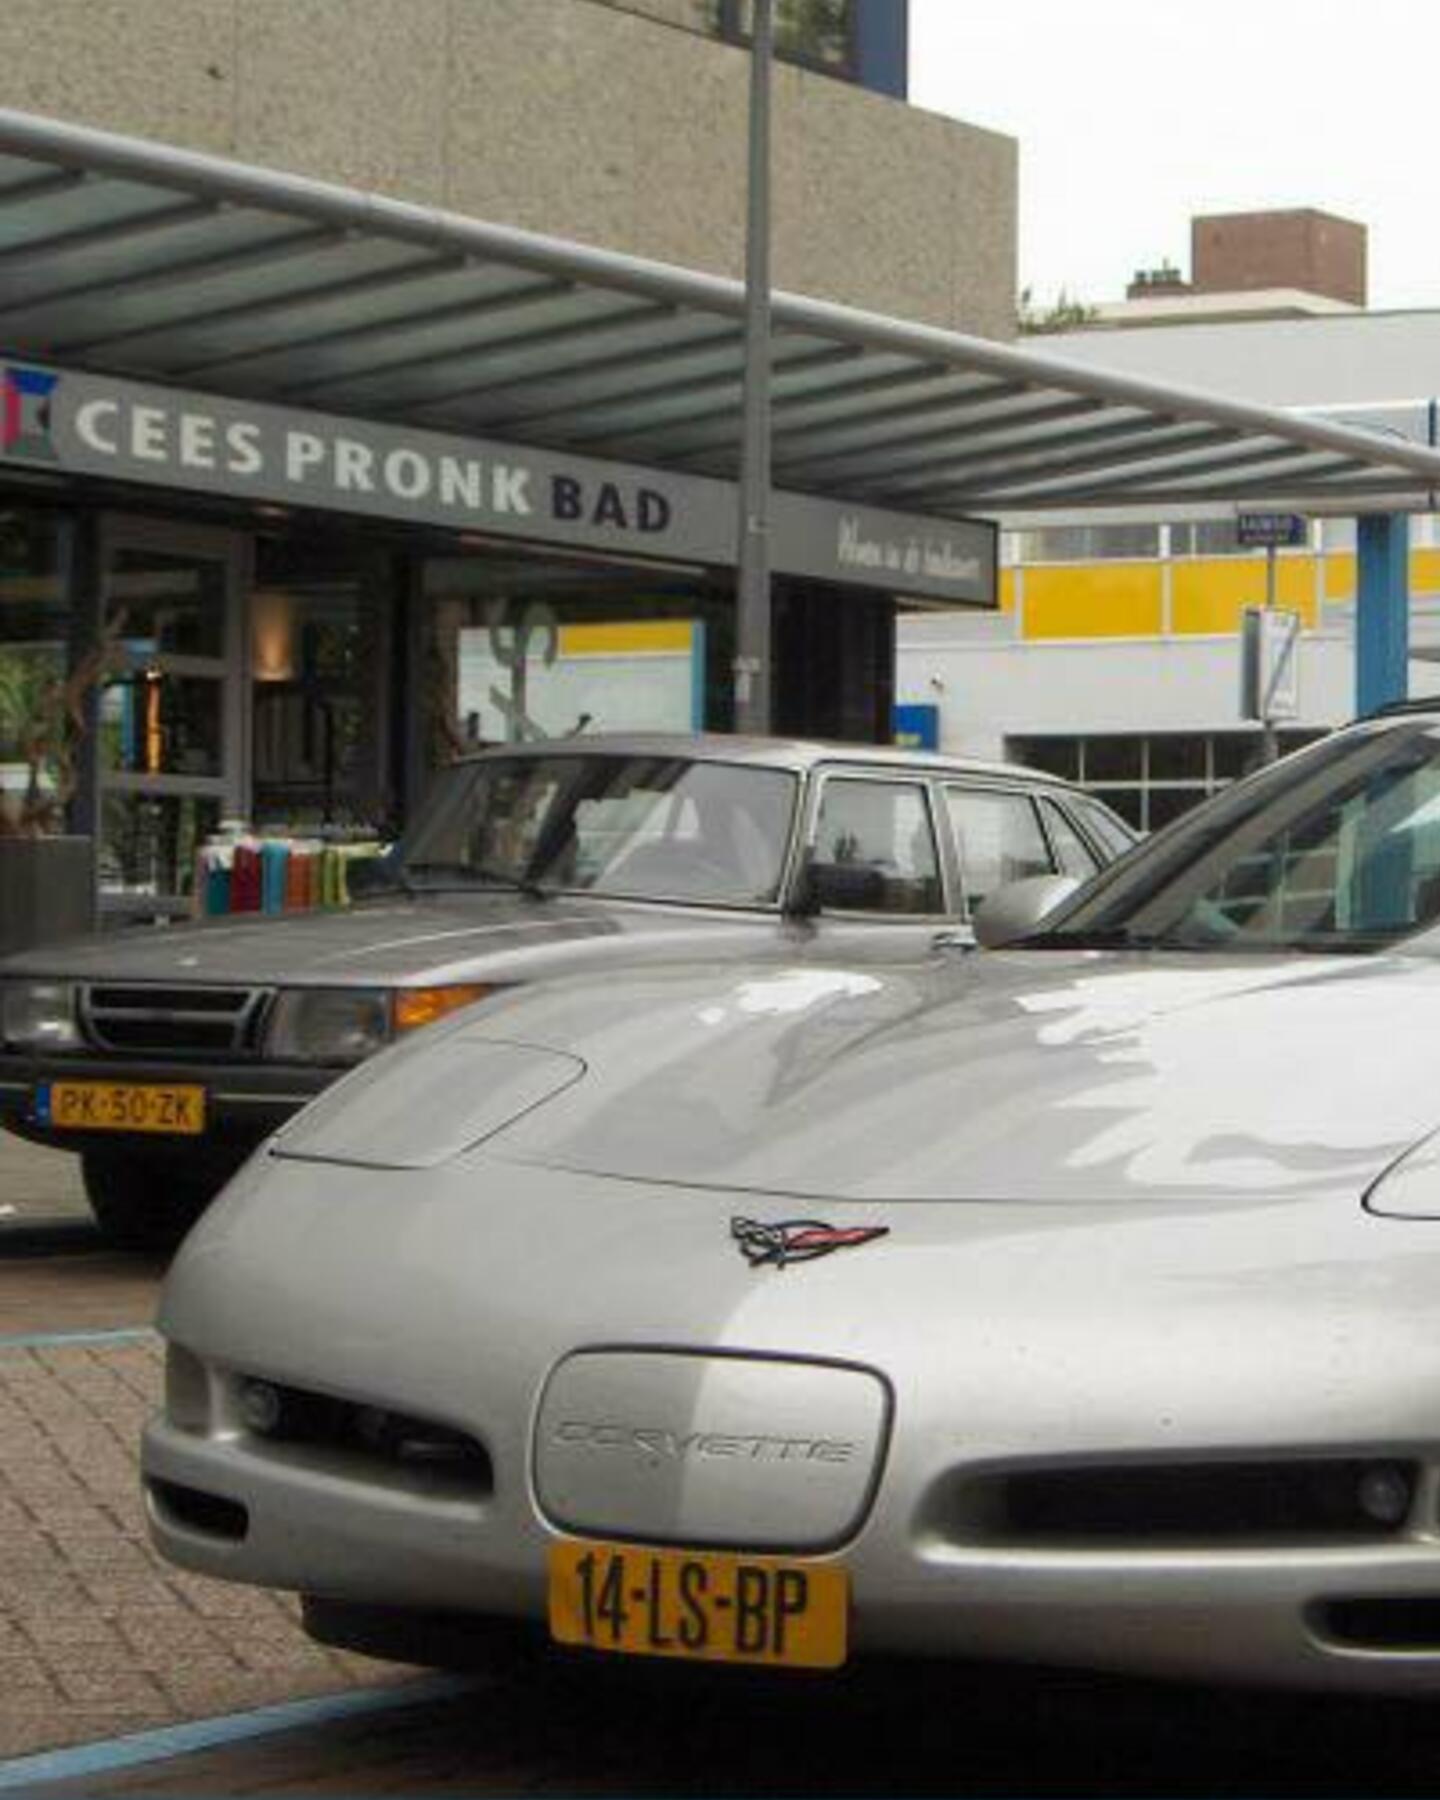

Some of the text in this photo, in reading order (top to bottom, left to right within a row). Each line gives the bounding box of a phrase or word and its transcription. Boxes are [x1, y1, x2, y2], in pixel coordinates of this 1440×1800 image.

[75, 400, 671, 533] CEES PRONK BAD
[555, 1420, 854, 1464] CORVETTE
[576, 1551, 808, 1657] 14-LS-BP
